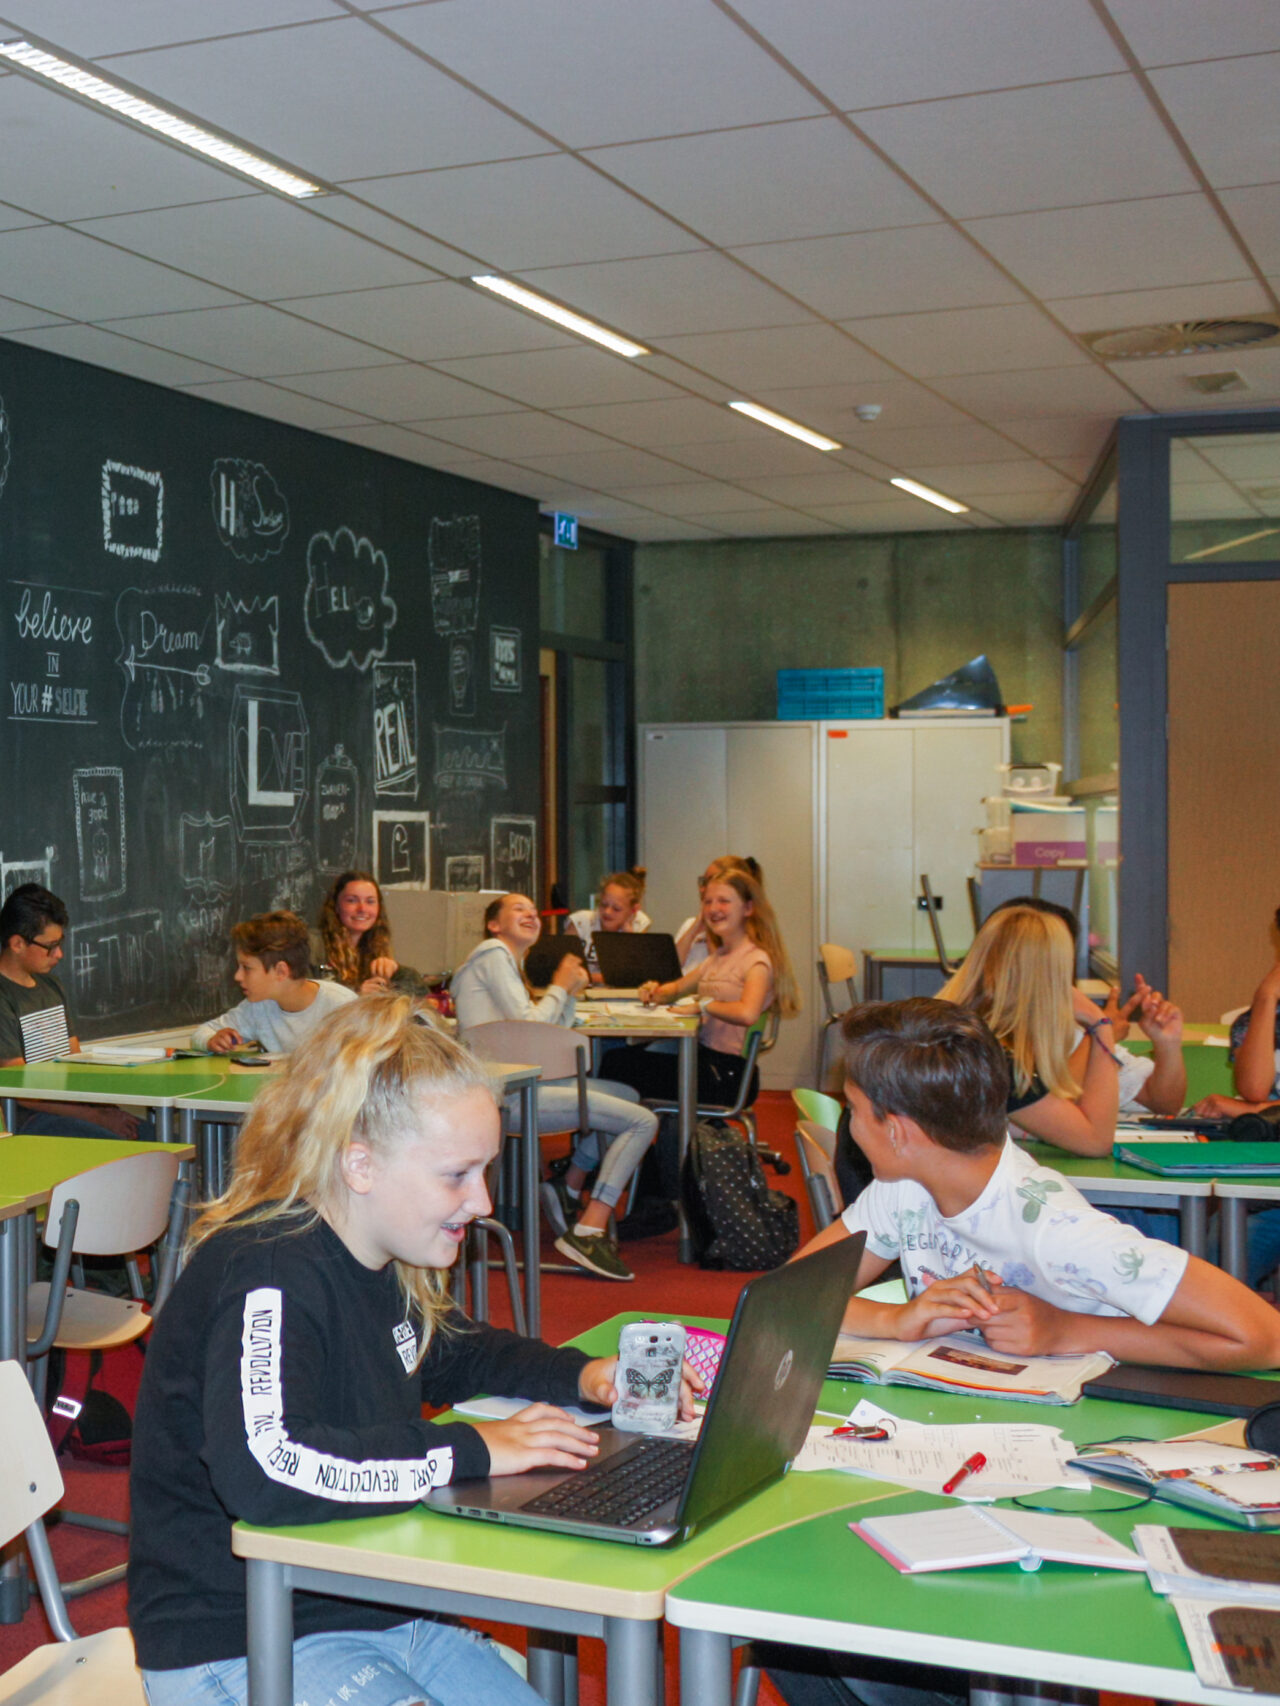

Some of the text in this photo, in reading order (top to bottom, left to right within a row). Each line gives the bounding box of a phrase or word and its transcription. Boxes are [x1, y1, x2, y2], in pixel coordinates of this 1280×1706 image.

[15, 588, 92, 645] believe
[137, 610, 199, 658] Dream
[46, 653, 60, 673] IN
[11, 680, 38, 714] YOUR
[250, 1308, 273, 1396] REVOLUTION
